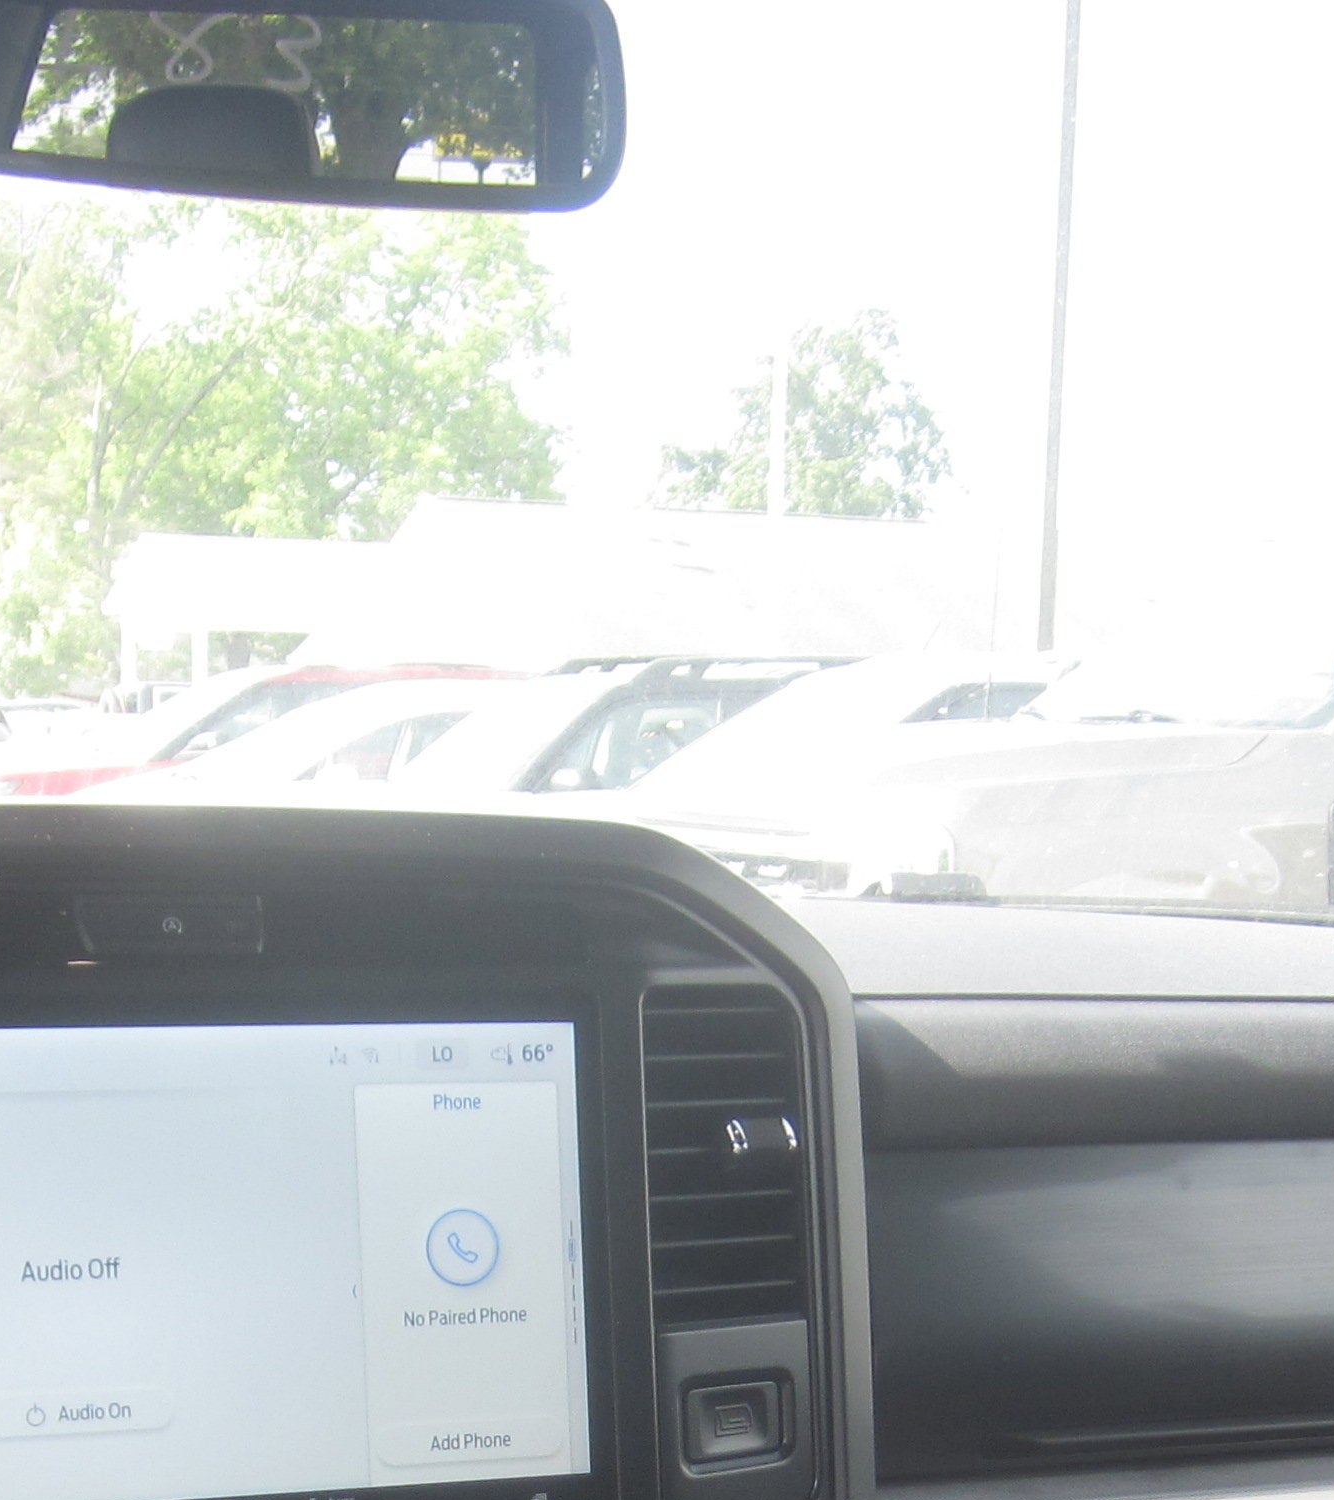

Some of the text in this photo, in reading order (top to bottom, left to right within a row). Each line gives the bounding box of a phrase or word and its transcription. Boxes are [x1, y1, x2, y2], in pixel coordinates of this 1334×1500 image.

[431, 1046, 454, 1063] LO
[521, 1043, 555, 1063] 66°
[432, 1093, 482, 1111] Phone
[20, 1256, 121, 1283] Audio Off
[403, 1307, 528, 1328] No Paired Phone
[58, 1402, 132, 1423] Audio On
[430, 1432, 512, 1451] Add Phone
